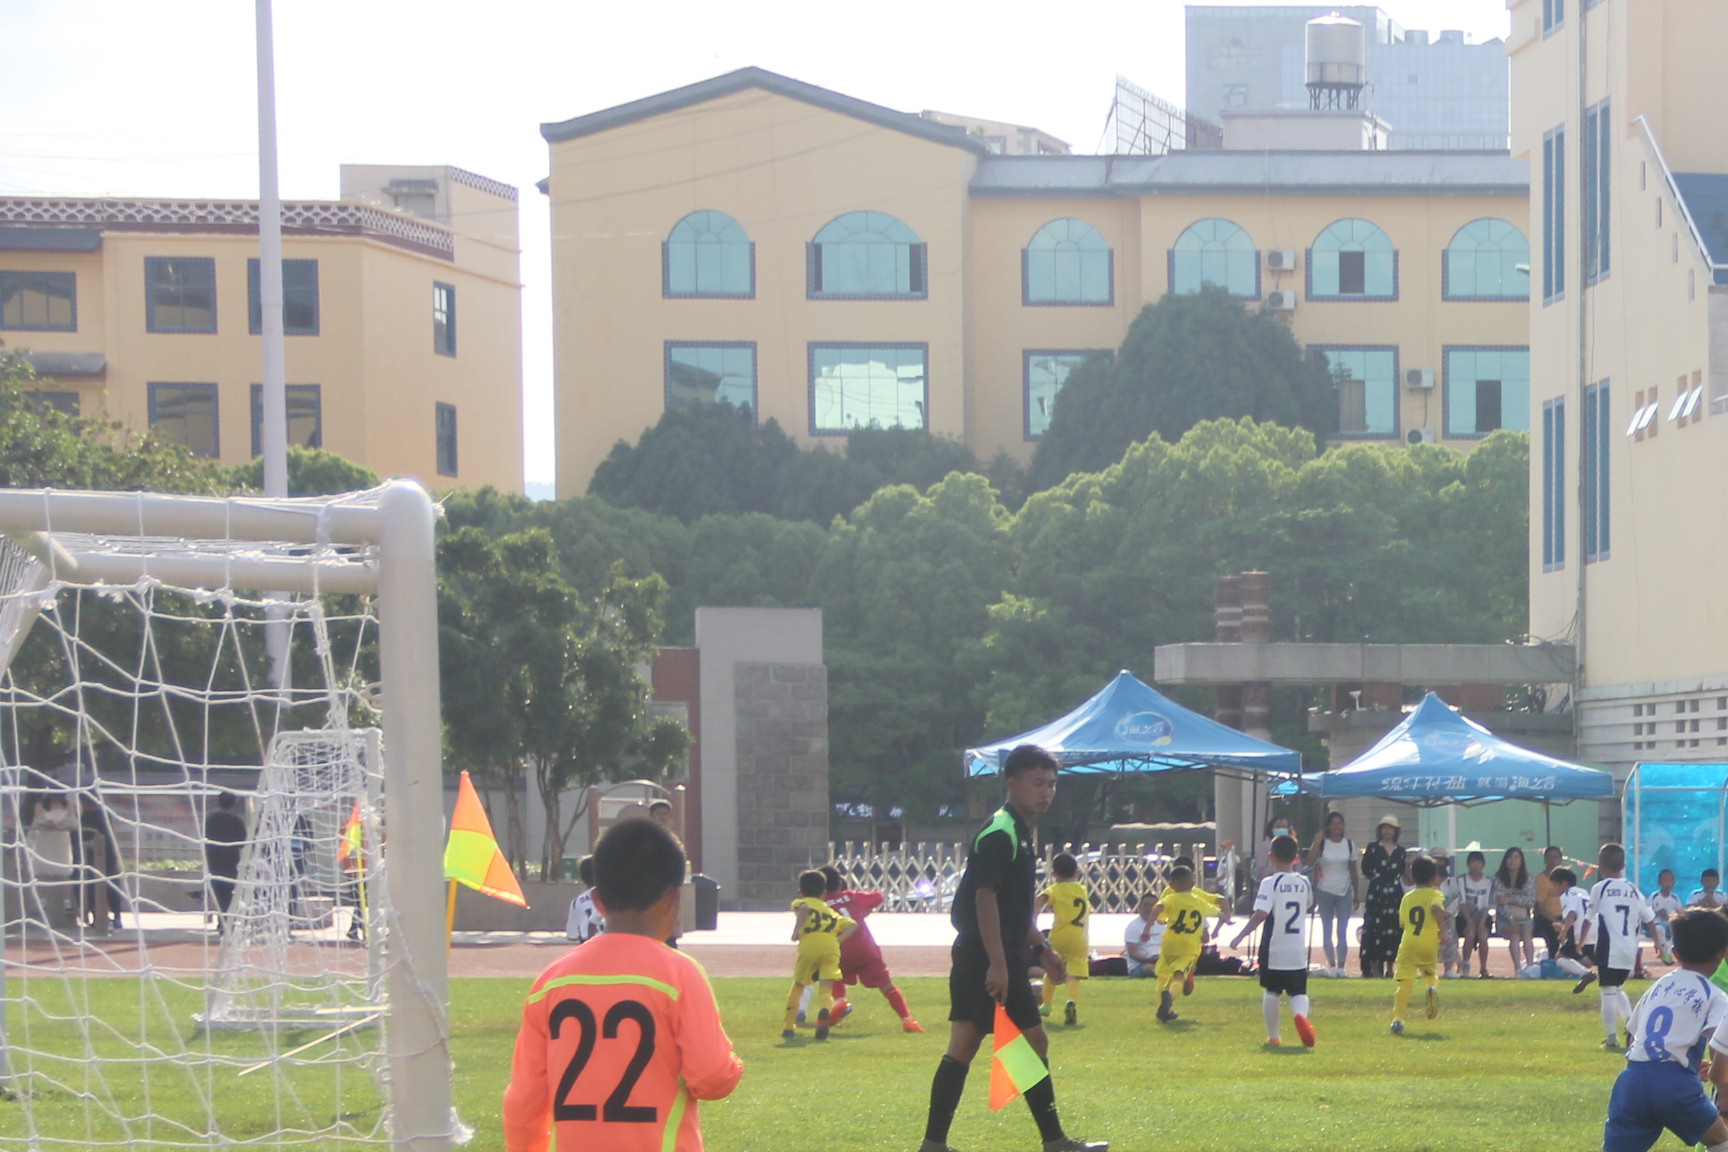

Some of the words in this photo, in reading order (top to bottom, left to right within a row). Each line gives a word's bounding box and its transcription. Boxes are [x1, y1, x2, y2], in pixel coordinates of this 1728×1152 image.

[804, 907, 838, 934] 37
[1071, 897, 1087, 927] 2
[1170, 908, 1203, 935] 43
[1284, 901, 1300, 933] 2
[1408, 905, 1425, 936] 9
[1615, 904, 1635, 936] 7
[1644, 1005, 1674, 1062] 8
[548, 998, 658, 1124] 22
